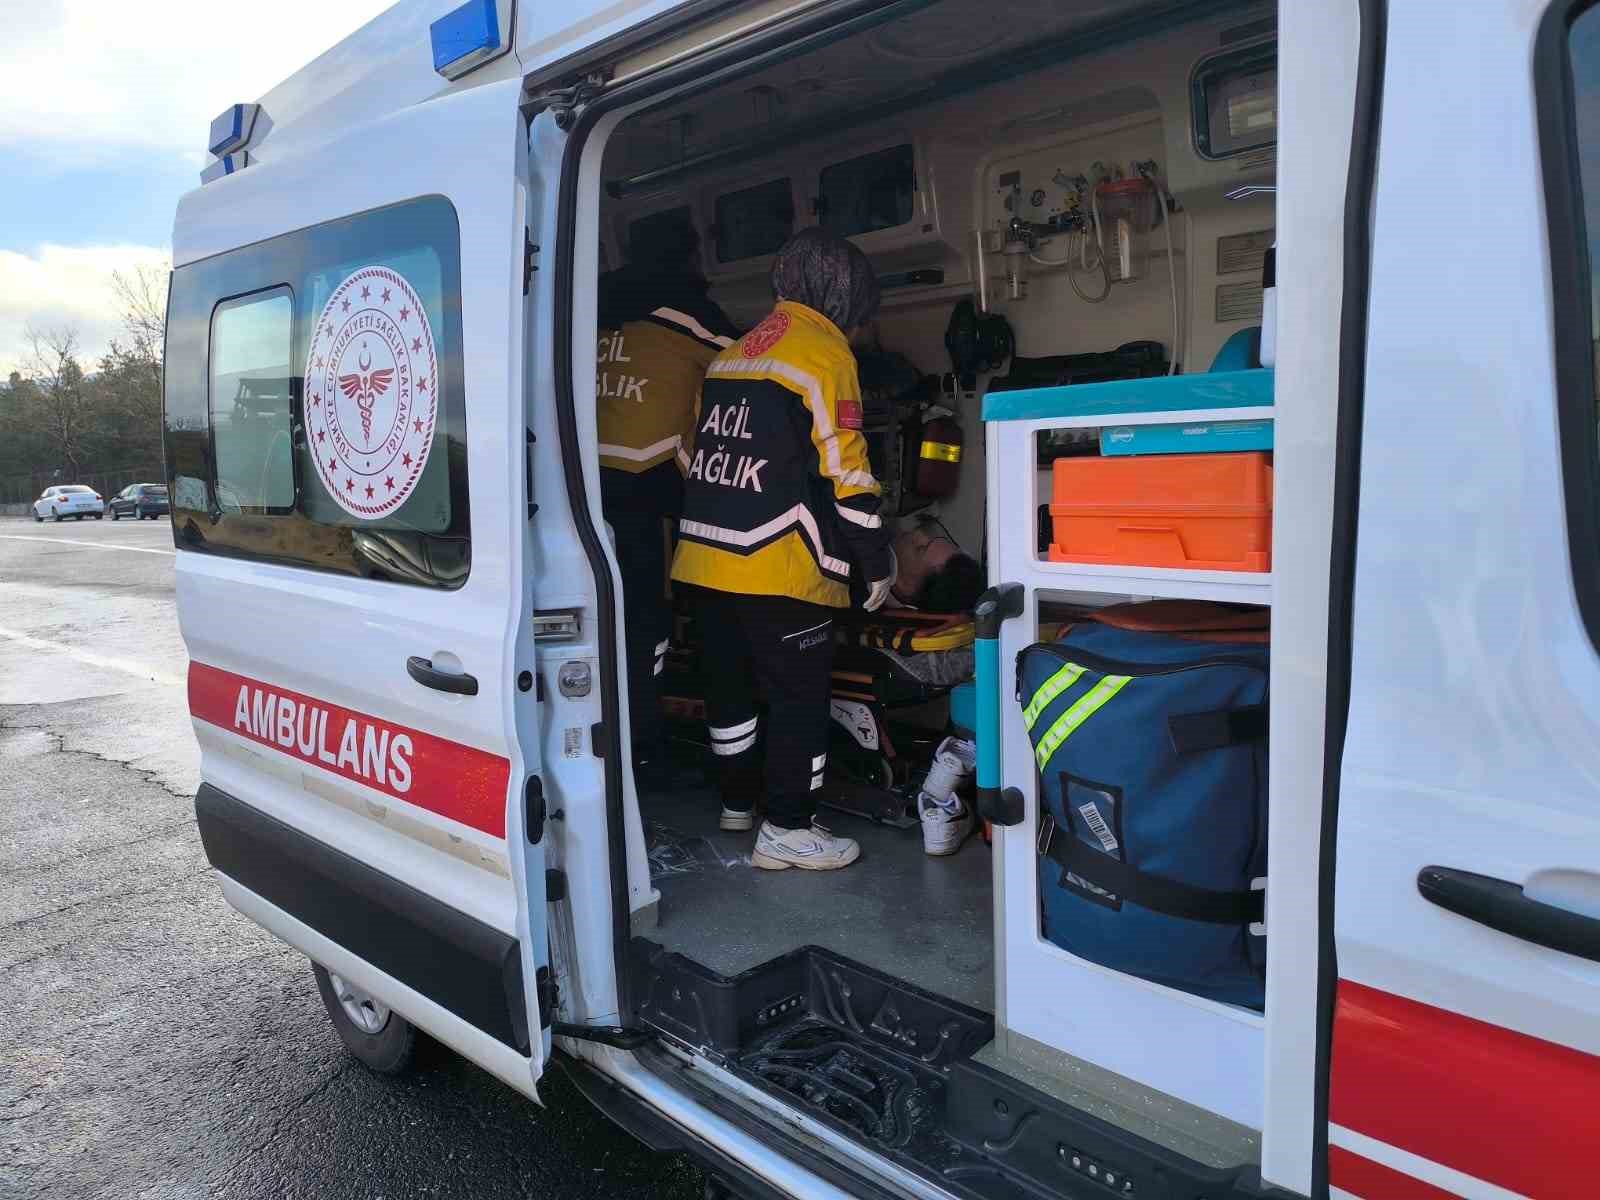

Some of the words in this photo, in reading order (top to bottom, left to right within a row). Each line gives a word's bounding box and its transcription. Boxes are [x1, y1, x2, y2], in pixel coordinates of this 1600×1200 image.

[598, 331, 631, 362] CİL
[701, 397, 752, 439] ACİL
[688, 443, 768, 493] AĞLIK
[234, 685, 414, 793] AMBULANS
